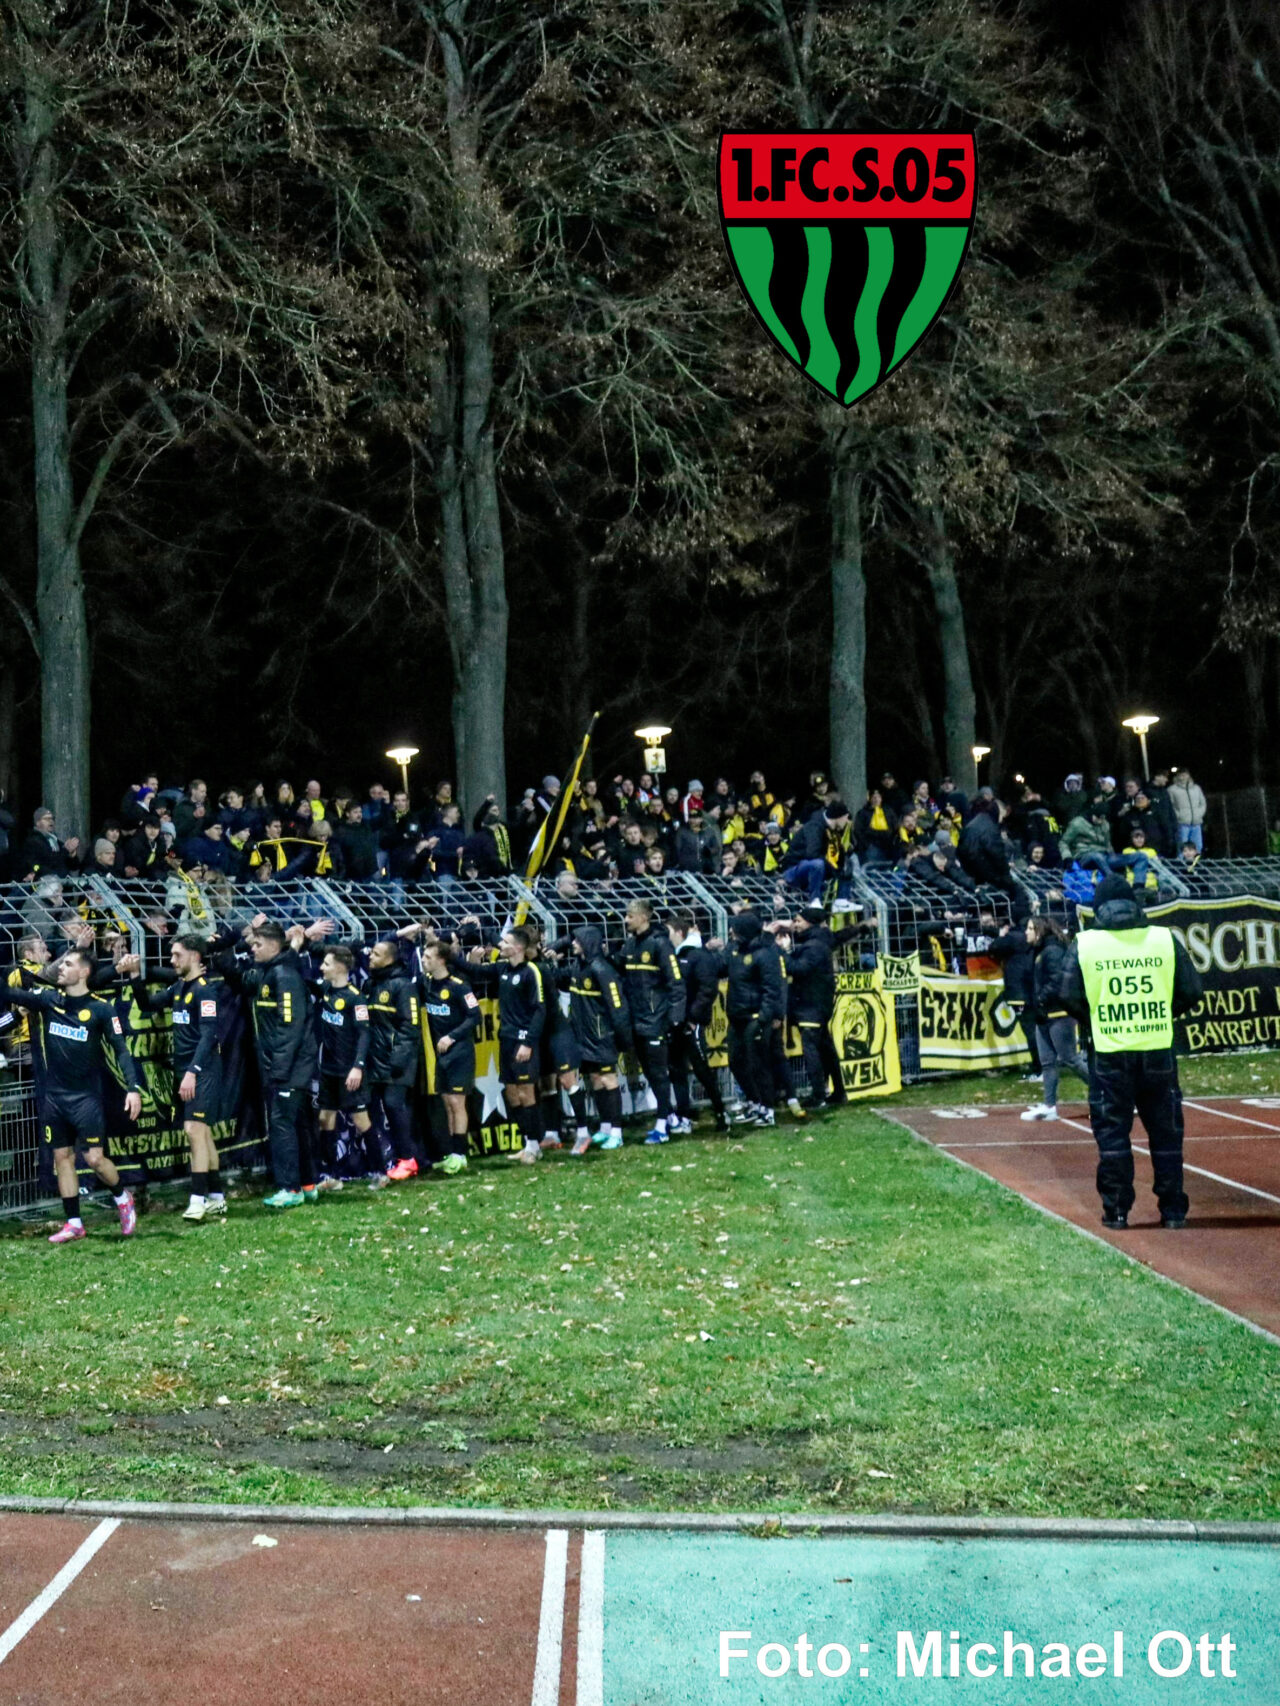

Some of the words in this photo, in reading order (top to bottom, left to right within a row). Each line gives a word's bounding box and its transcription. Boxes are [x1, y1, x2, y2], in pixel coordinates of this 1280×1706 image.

[1171, 919, 1280, 973] SCH
[1095, 957, 1163, 971] STEWARD
[1109, 975, 1153, 996] 055
[1098, 1000, 1167, 1022] EMPIRE
[1181, 986, 1261, 1018] STADT
[921, 987, 988, 1041] SZENE
[50, 1022, 88, 1042] maxit
[1134, 1022, 1168, 1033] SUPPORT
[841, 1057, 882, 1086] WSK
[45, 1125, 52, 1144] 9
